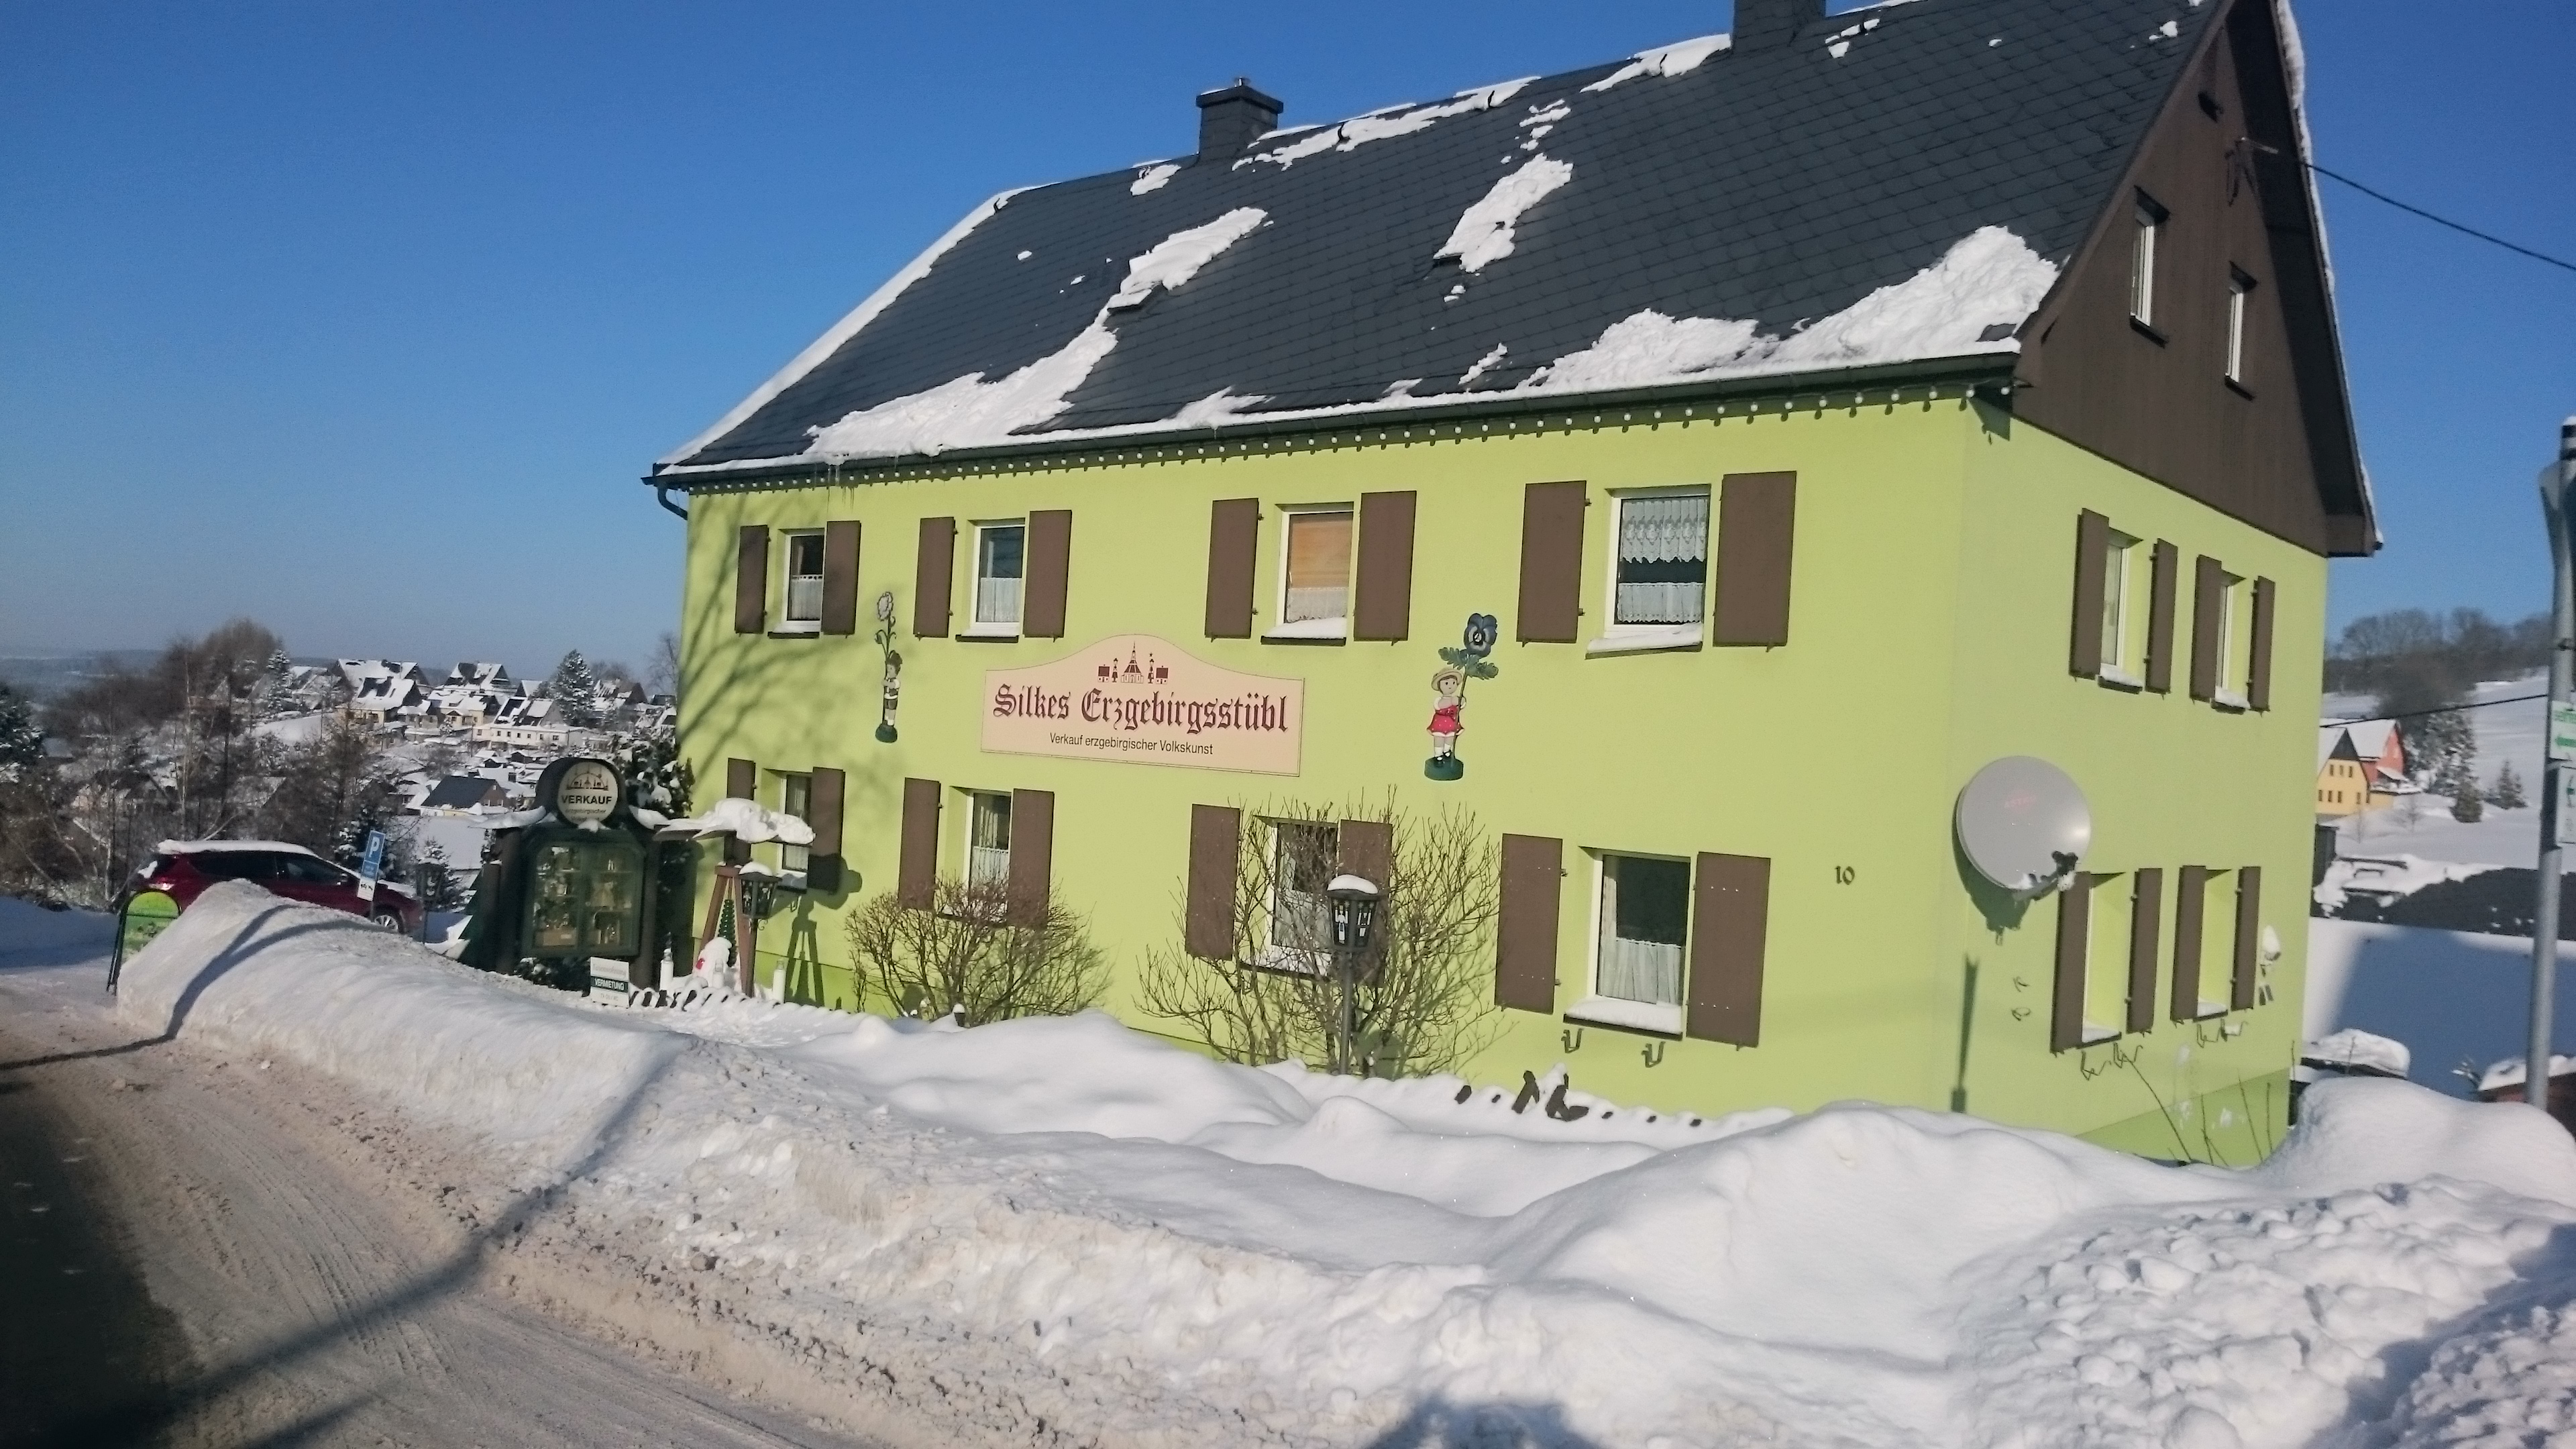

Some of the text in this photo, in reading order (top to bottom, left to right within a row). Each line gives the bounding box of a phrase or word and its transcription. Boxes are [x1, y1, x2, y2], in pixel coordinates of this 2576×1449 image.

[994, 684, 1287, 734] Silkes Erzgebirgsstübl
[1050, 733, 1213, 755] Verkauf erzgebirgischer Volkskunst
[561, 795, 612, 804] VERKAUF
[369, 837, 380, 857] P
[1835, 865, 1855, 885] 10
[594, 977, 625, 990] VERMIETUNG
